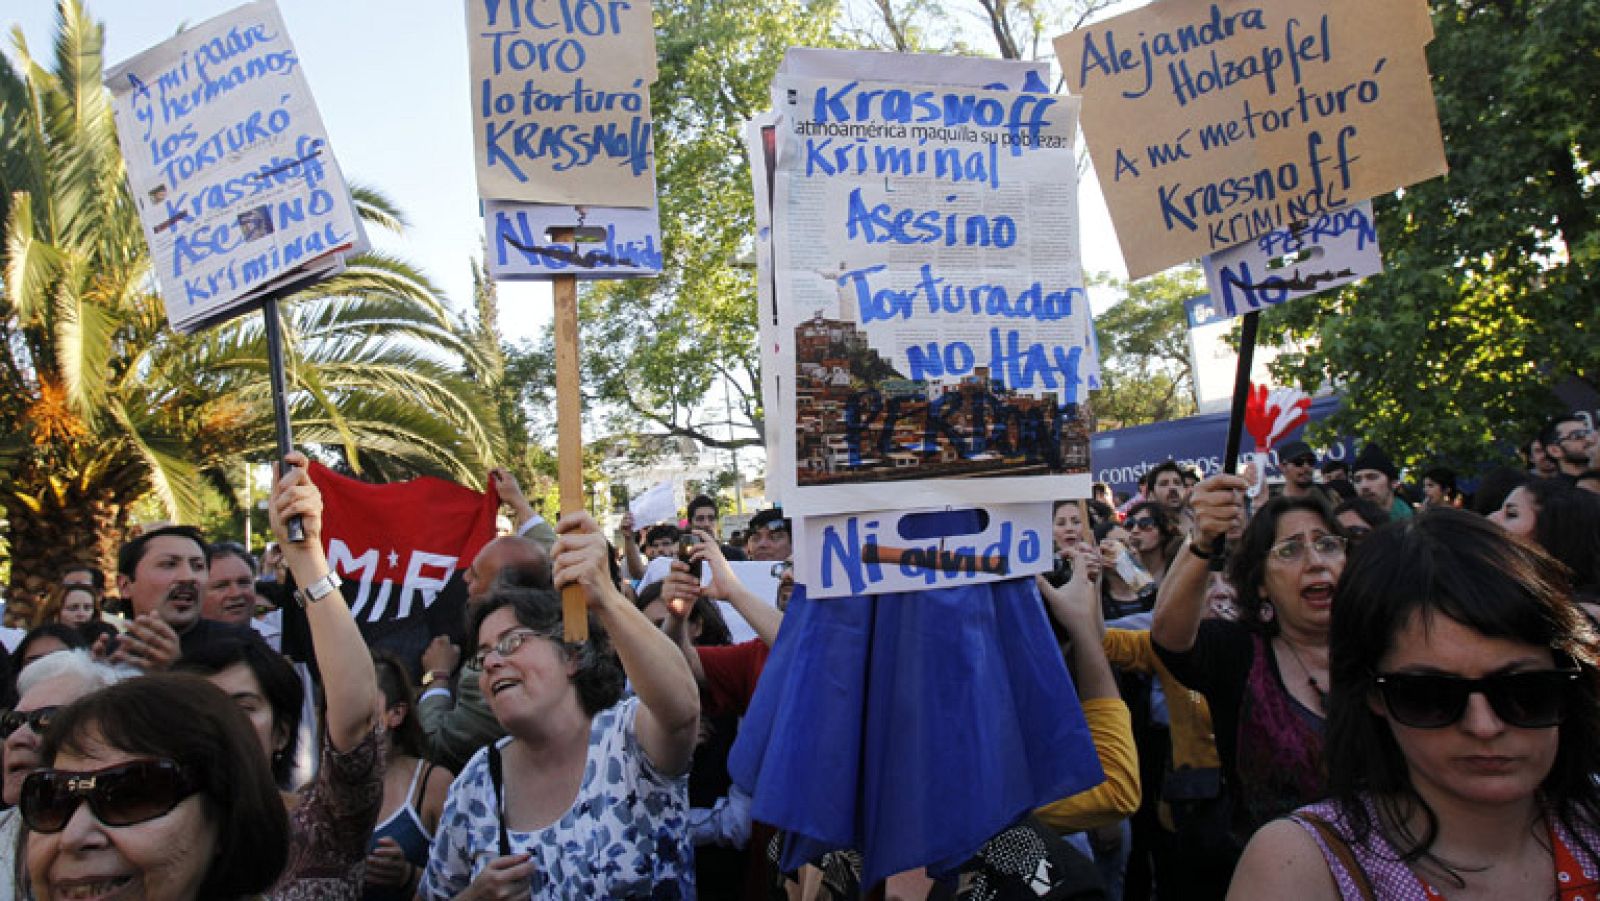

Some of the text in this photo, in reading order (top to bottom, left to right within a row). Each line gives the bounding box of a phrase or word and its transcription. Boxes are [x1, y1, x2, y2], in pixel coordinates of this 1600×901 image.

[481, 31, 587, 75] Toro
[1079, 4, 1267, 98] Alejandra
[1168, 14, 1331, 107] Holzapfel
[127, 72, 150, 106] A
[136, 104, 155, 142] y
[158, 93, 290, 191] TORTURÓ
[980, 130, 999, 144] su
[805, 137, 999, 190] Kriminal
[1114, 147, 1139, 182] A
[1157, 126, 1360, 232] Krassnoff
[846, 187, 1017, 248] Asesino
[836, 263, 1085, 325] Torturador
[1220, 260, 1290, 317] No
[820, 516, 884, 594] Ni
